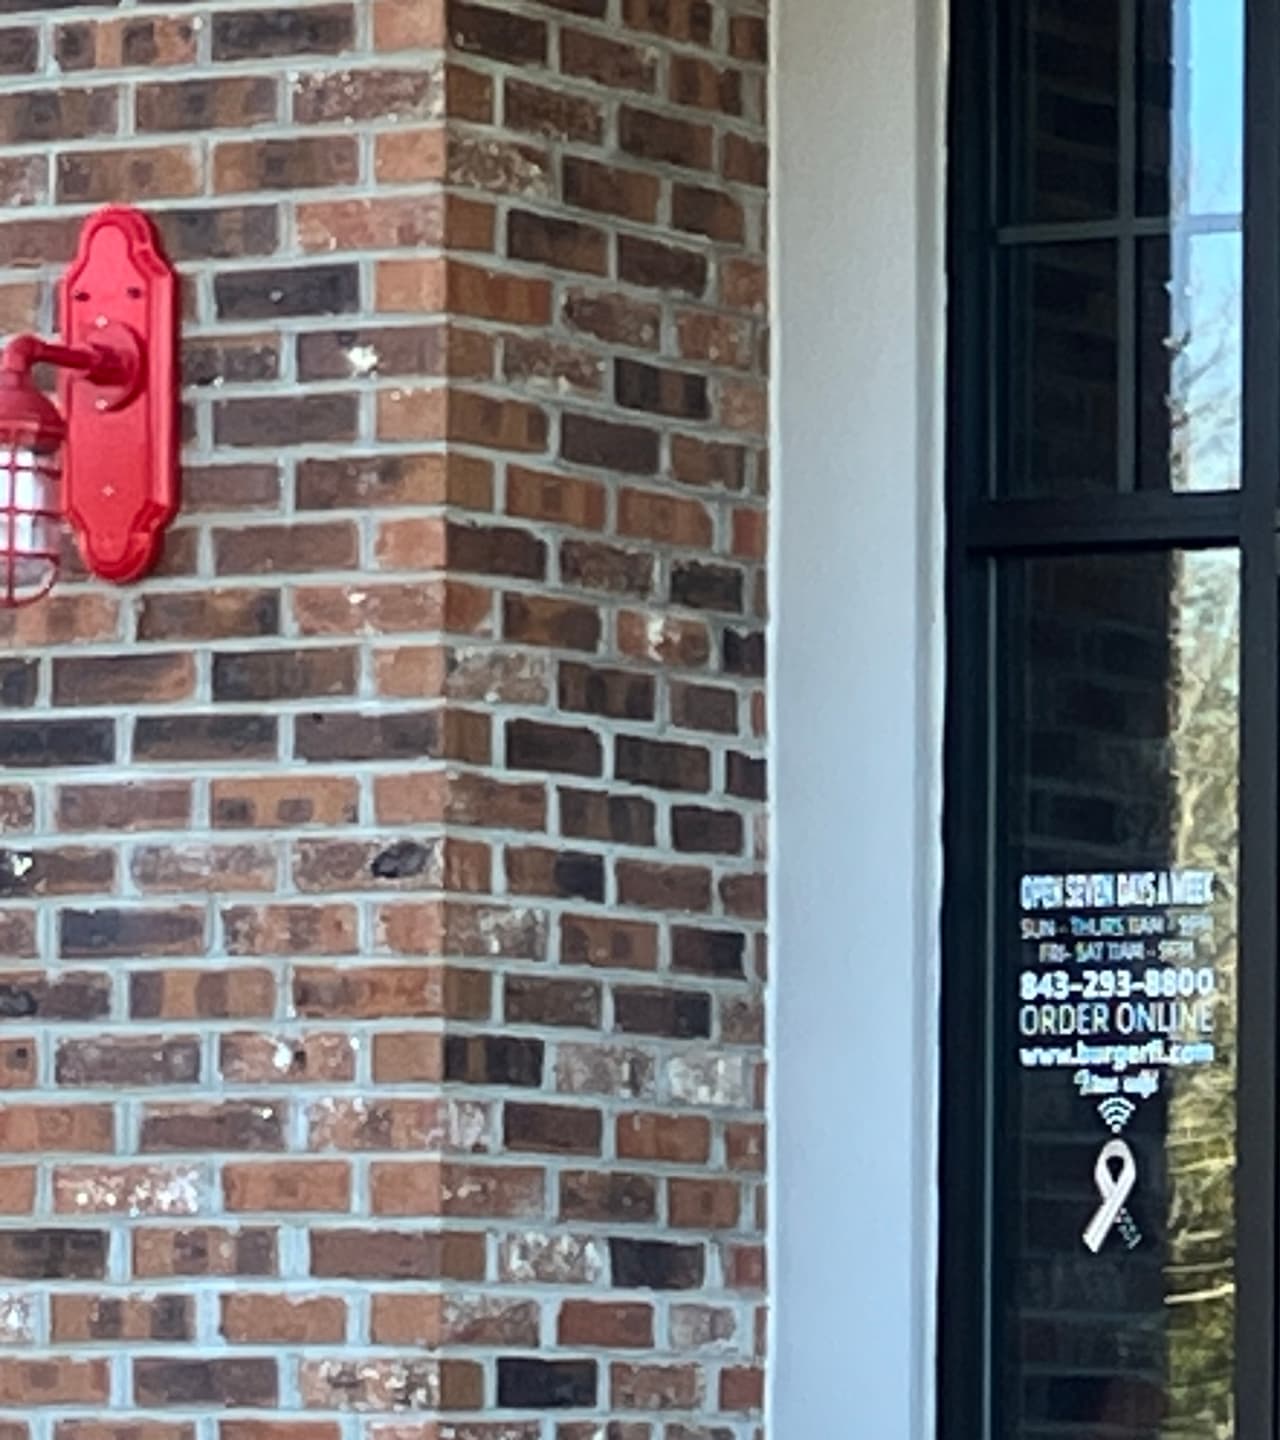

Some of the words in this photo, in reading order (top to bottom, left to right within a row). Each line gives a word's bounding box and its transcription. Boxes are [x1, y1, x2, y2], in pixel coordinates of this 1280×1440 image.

[1065, 873, 1115, 908] SEVEN
[1117, 872, 1156, 907] DAYS
[1019, 968, 1215, 1000] 843-293-8800
[1019, 1003, 1110, 1035] ORDER
[1115, 1001, 1215, 1034] ONLINE
